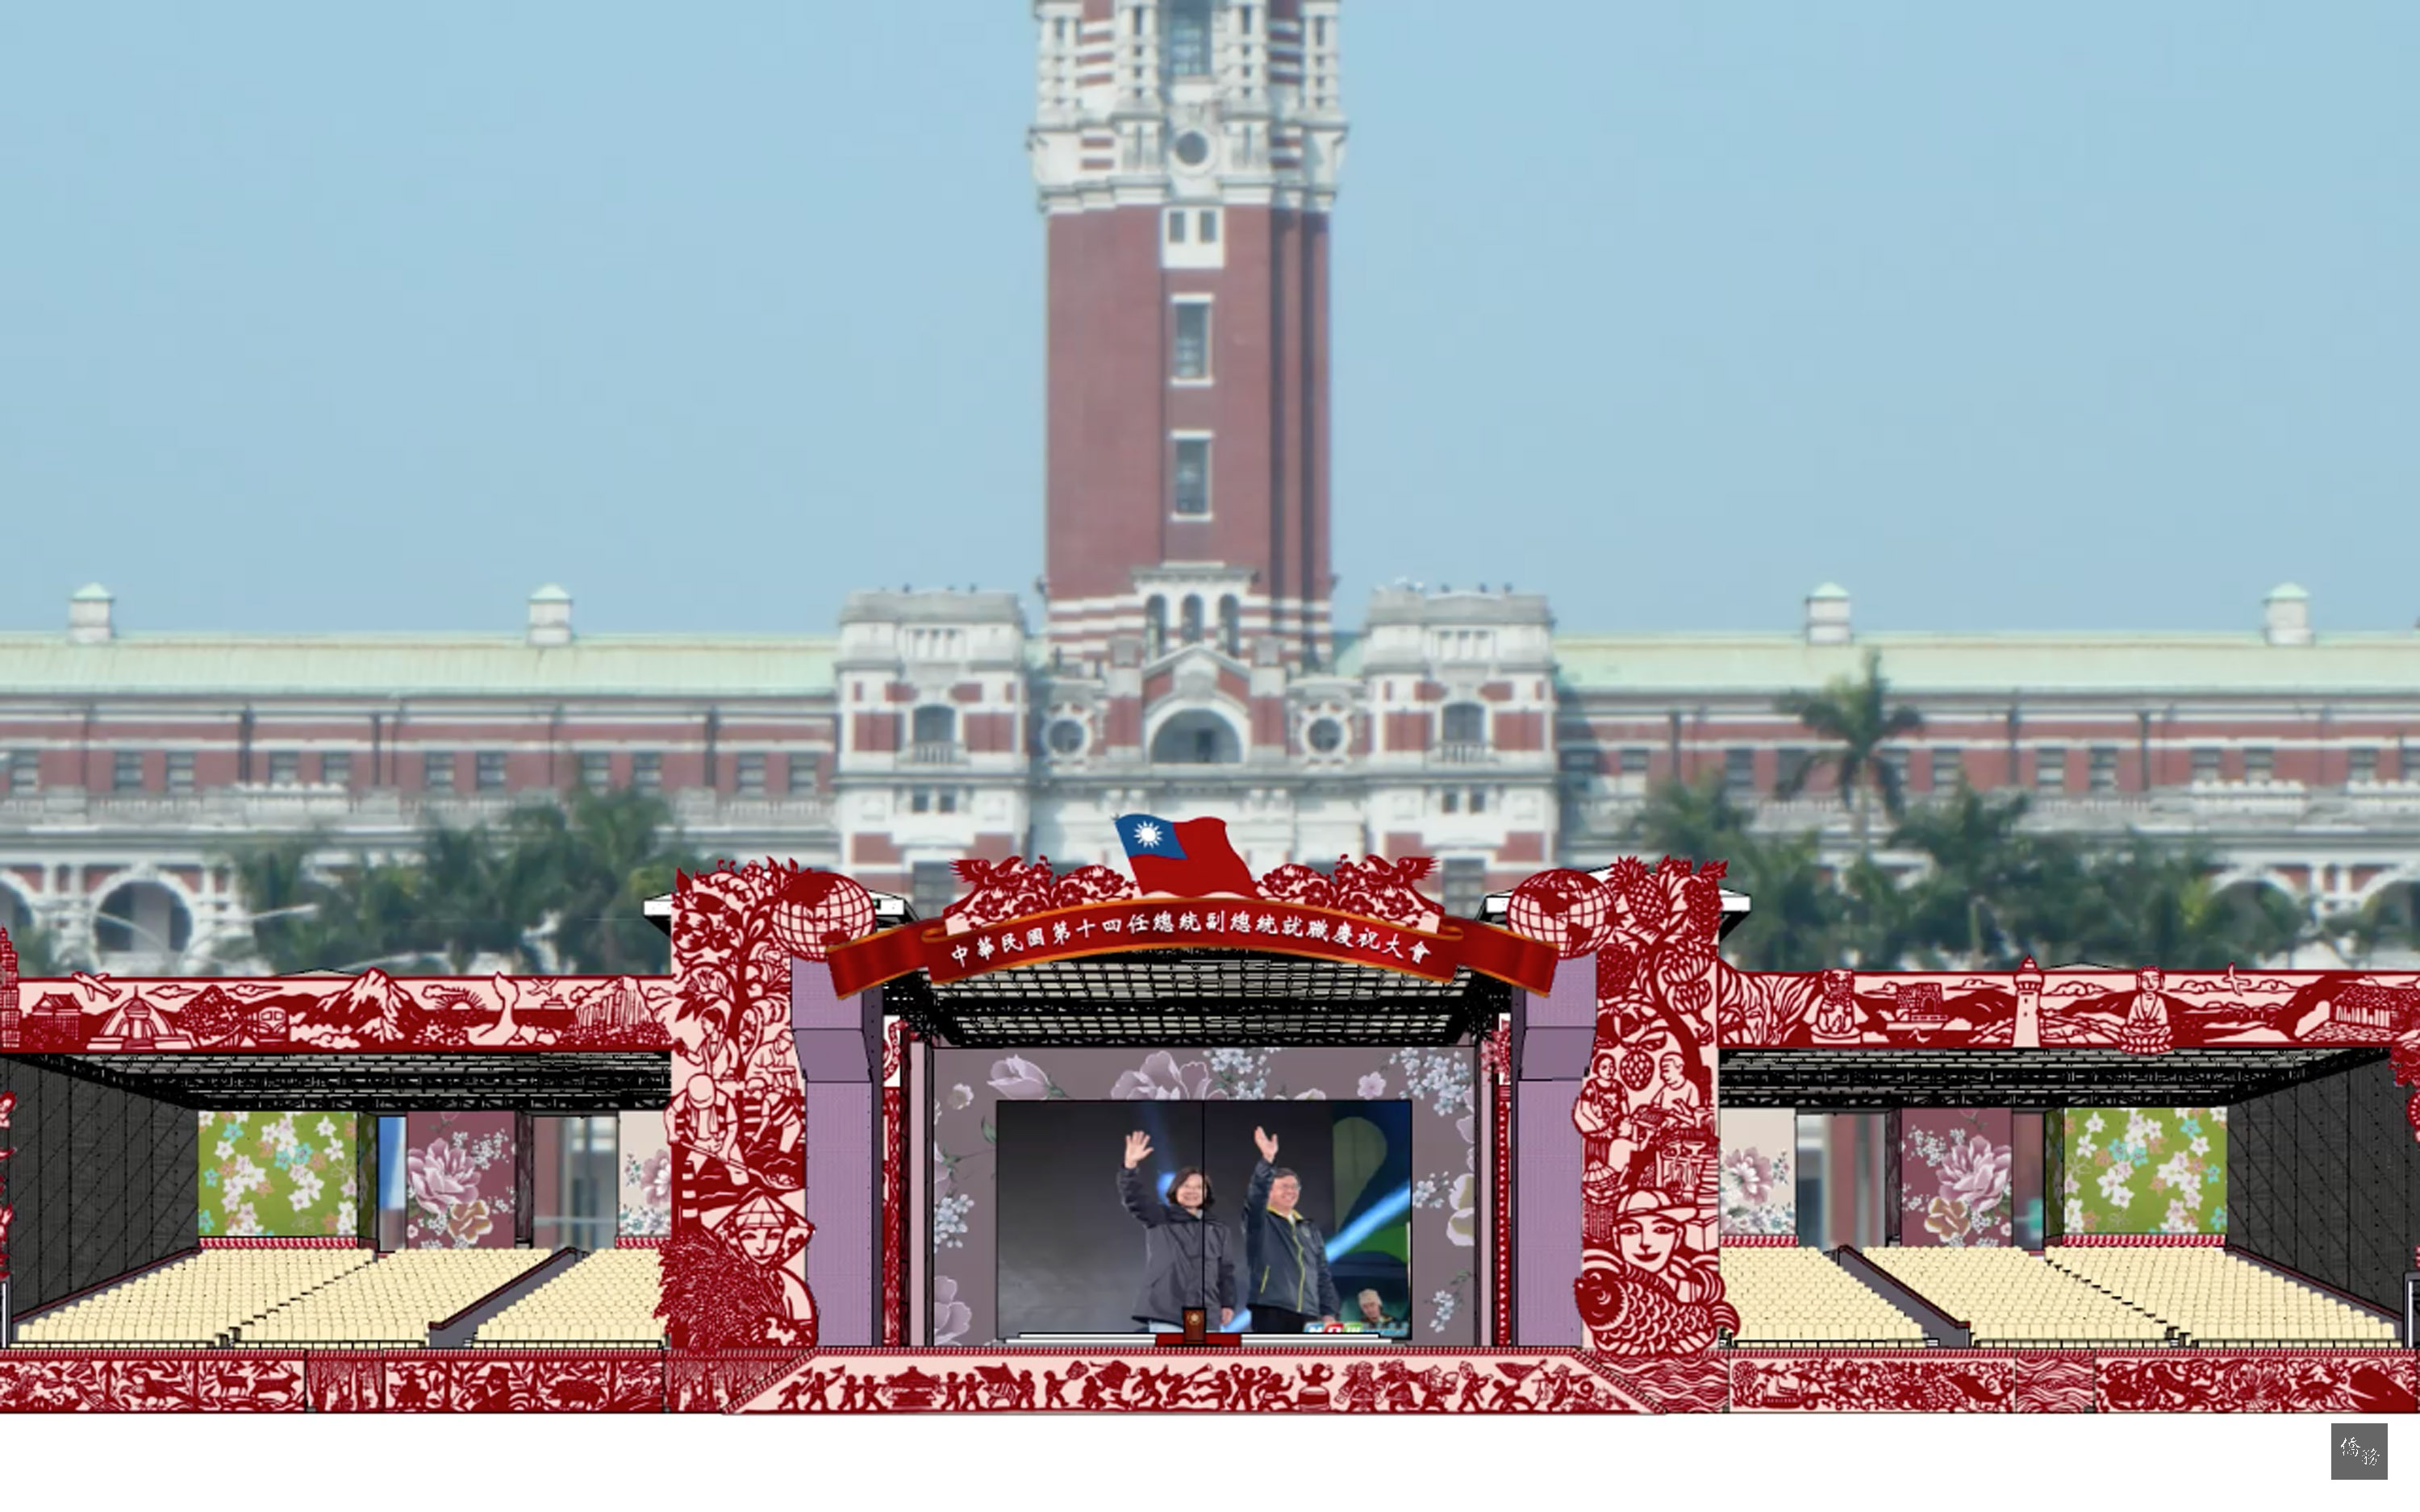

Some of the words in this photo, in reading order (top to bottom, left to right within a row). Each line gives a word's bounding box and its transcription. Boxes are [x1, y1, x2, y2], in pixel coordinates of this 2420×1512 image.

[951, 910, 1431, 968] 中華民國第十四任總統副總統就職慶祝大會
